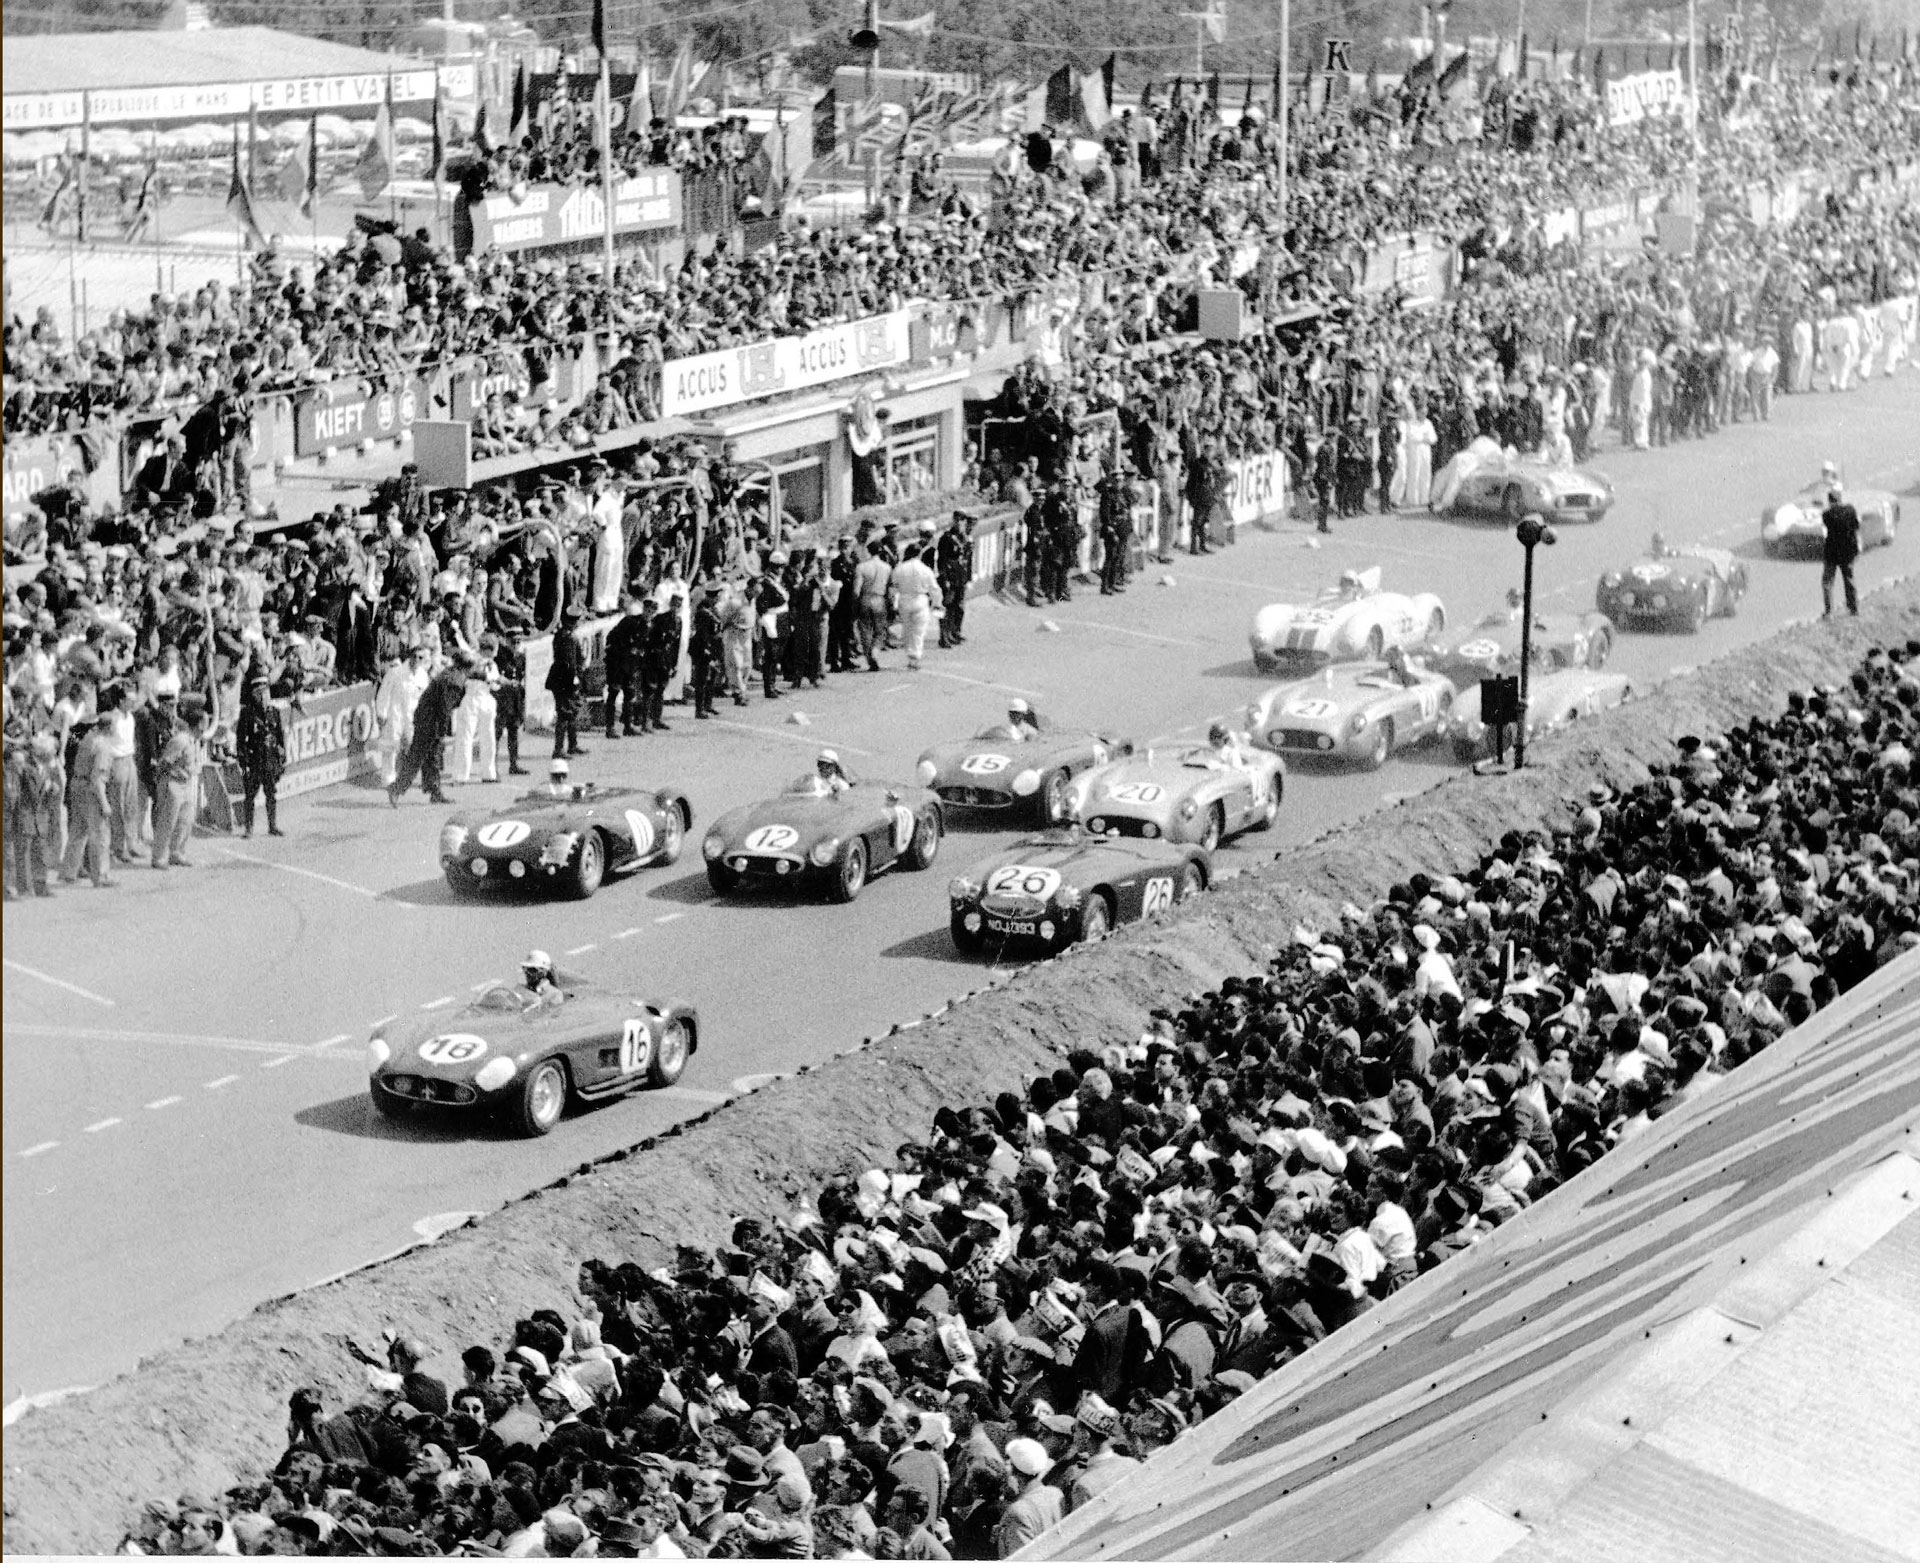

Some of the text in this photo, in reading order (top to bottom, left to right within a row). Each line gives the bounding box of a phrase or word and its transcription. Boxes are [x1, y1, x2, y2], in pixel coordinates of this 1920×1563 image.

[286, 79, 345, 104] PETIT
[799, 337, 846, 374] ACCUS
[677, 362, 728, 401] ACCUS
[315, 402, 366, 440] KIEFT
[1229, 460, 1273, 511] PICER
[1295, 701, 1330, 716] 21
[283, 702, 380, 764] NERGOL
[966, 754, 1001, 772] 15
[1115, 784, 1162, 802] 20
[487, 823, 520, 842] 11
[757, 818, 793, 849] 12
[994, 867, 1052, 894] 26
[1148, 878, 1171, 914] 26
[431, 1038, 478, 1060] 16
[626, 1025, 647, 1067] 16
